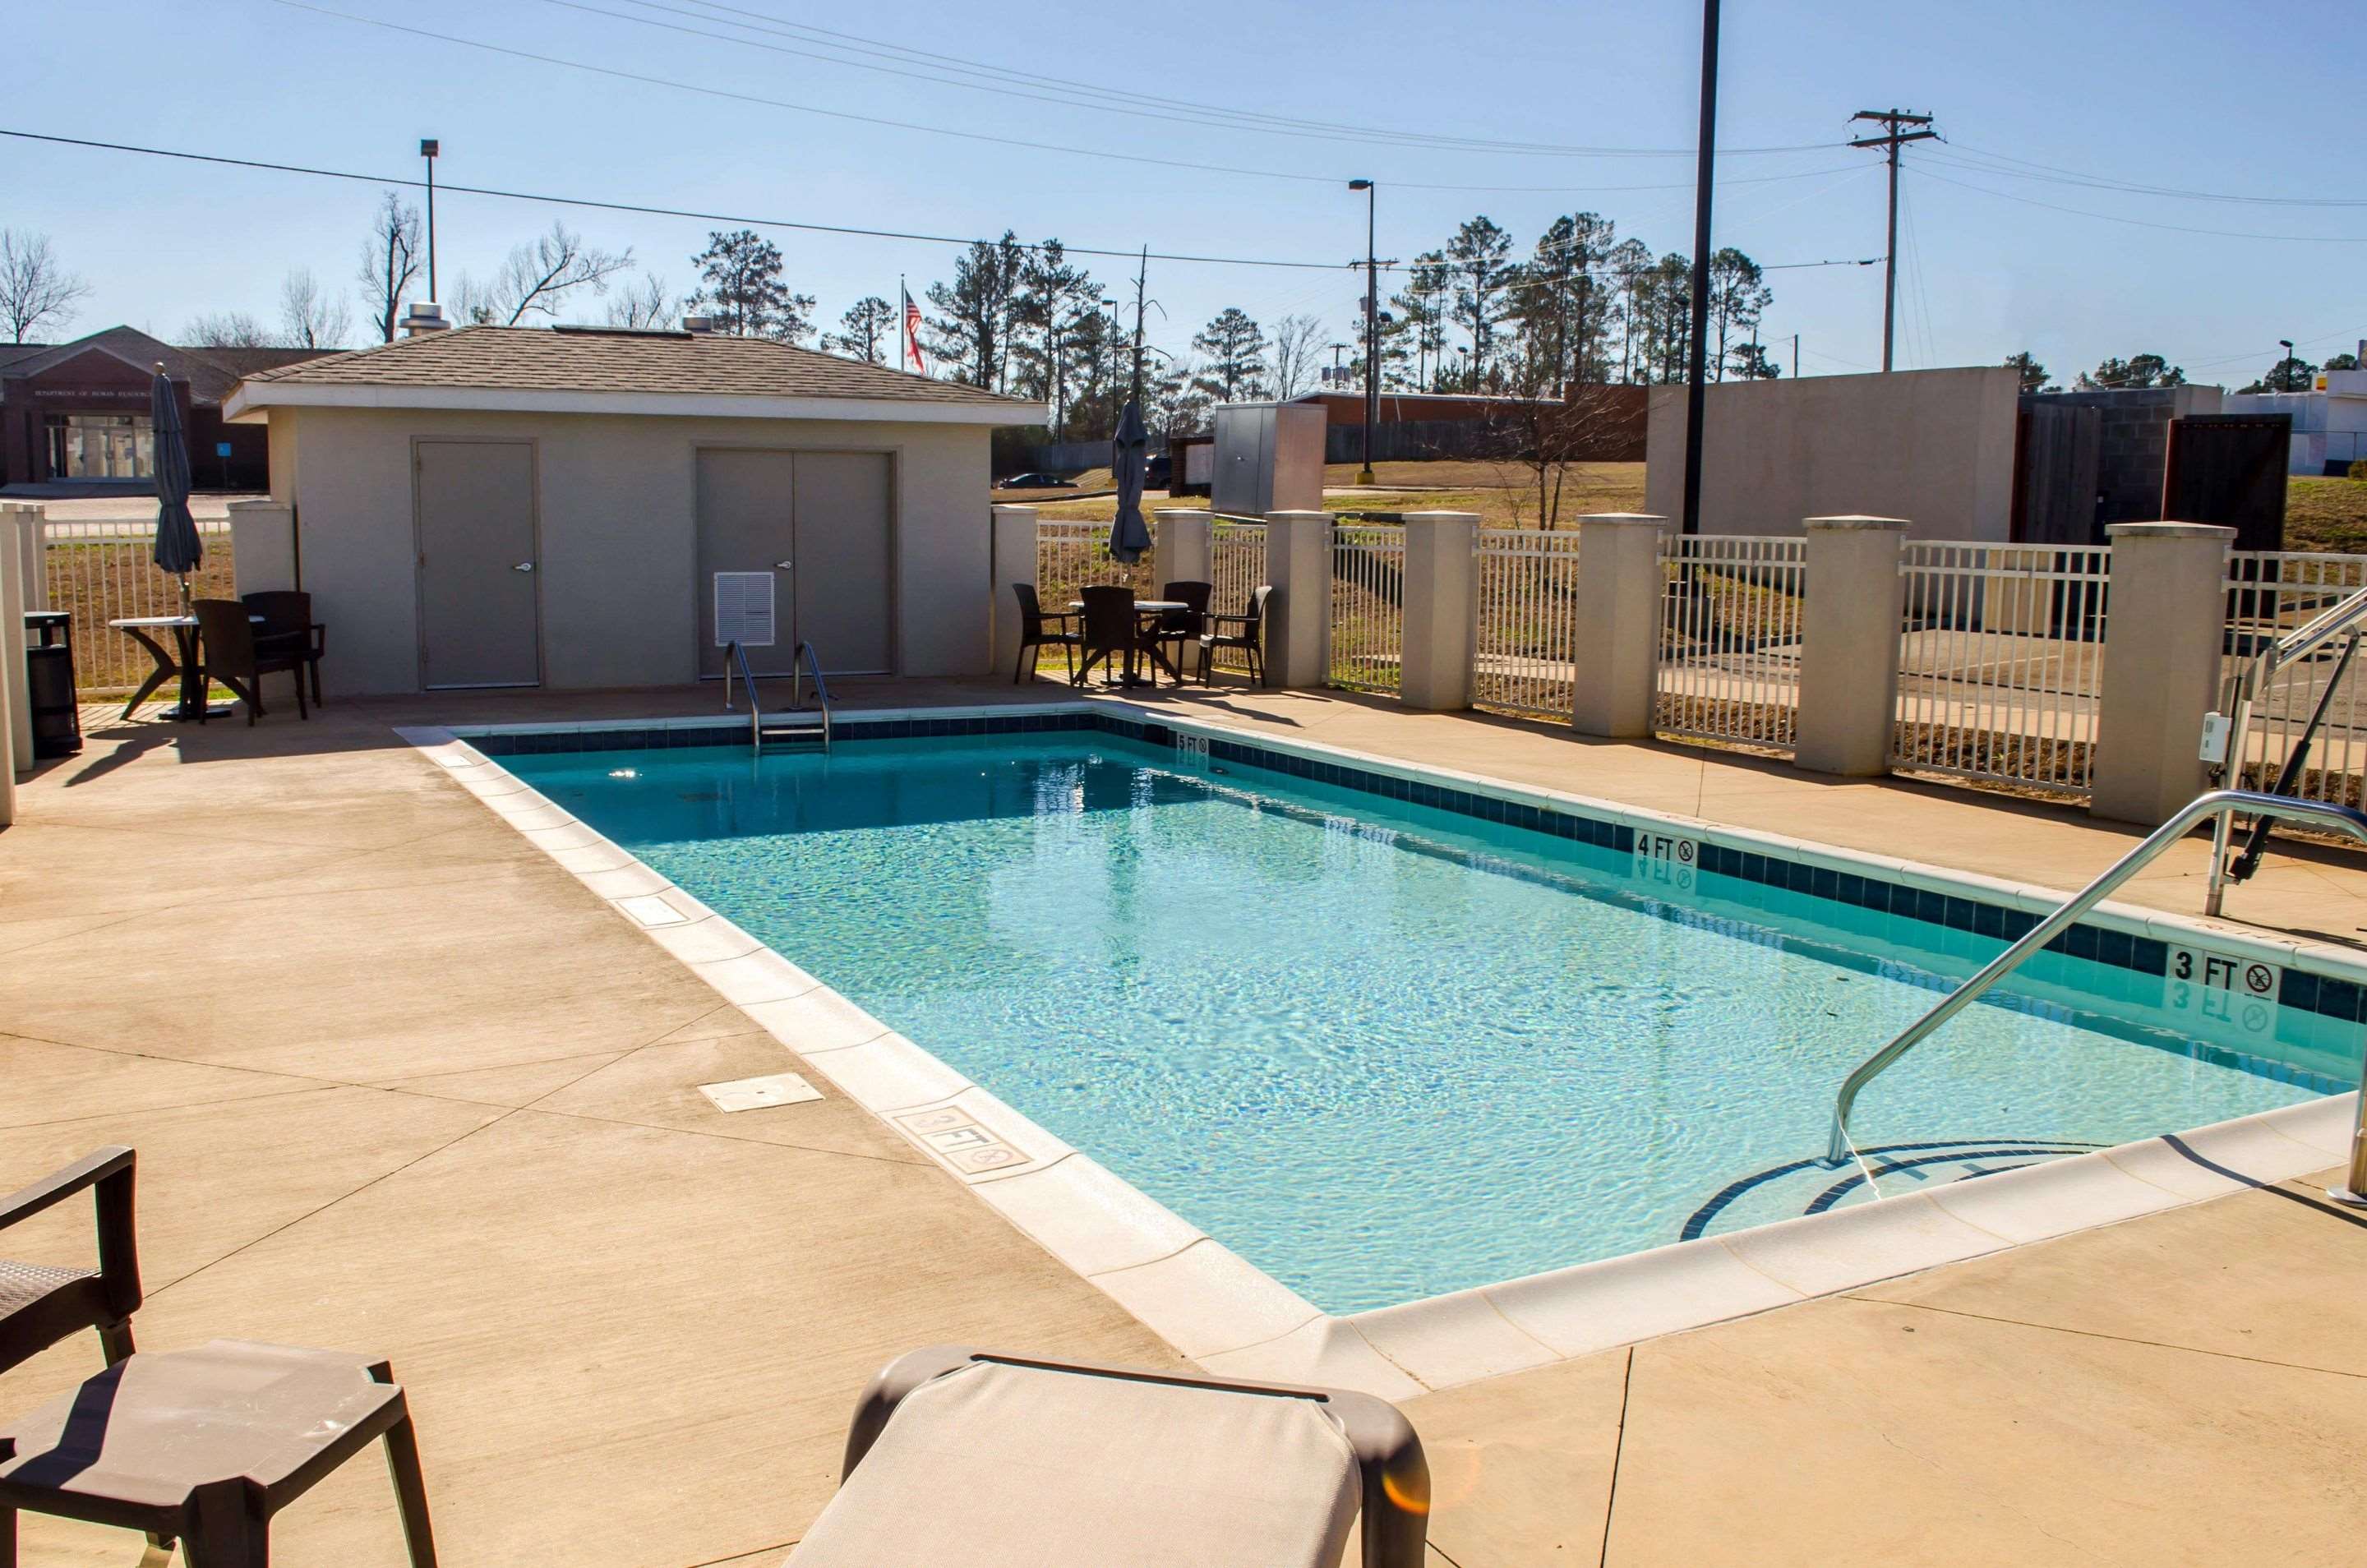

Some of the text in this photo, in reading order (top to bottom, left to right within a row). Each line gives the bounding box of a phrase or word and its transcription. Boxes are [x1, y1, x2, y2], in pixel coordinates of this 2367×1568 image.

[1179, 735, 1197, 752] 5 FT
[1638, 834, 1673, 860] 4 FT
[2175, 951, 2238, 990] 3 FT
[915, 1114, 990, 1147] 3 FT
